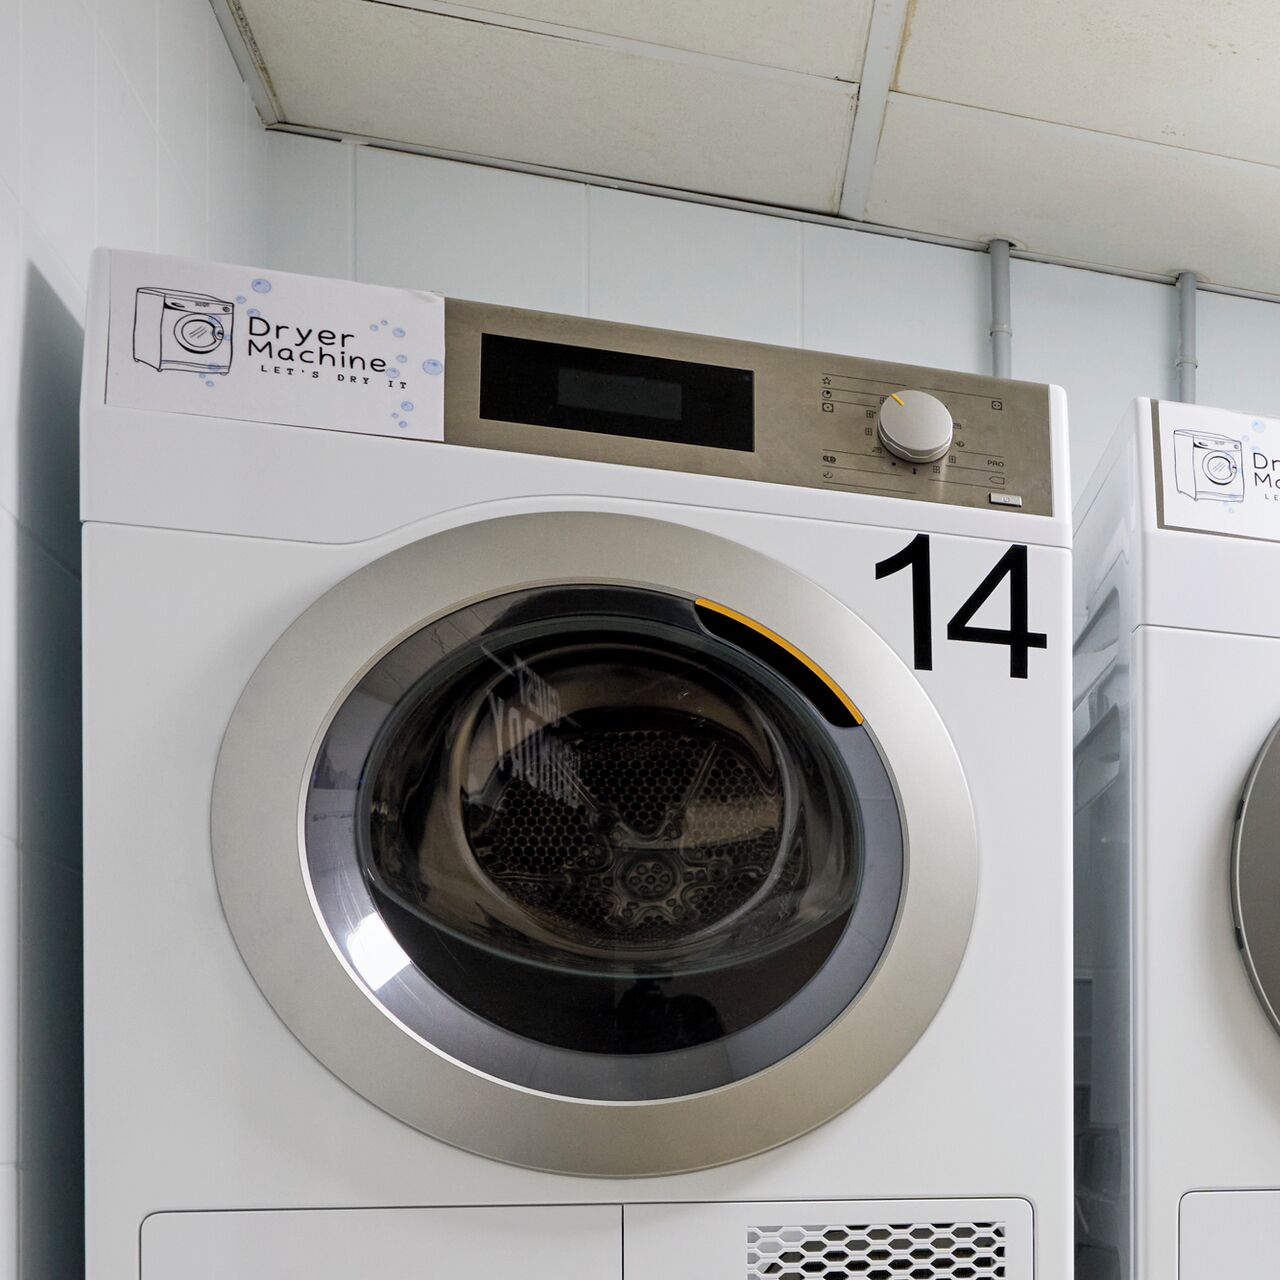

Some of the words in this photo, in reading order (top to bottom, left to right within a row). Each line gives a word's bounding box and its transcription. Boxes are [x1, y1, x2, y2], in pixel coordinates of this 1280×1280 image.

[248, 316, 355, 348] Dryer
[248, 339, 387, 373] Machine
[261, 365, 319, 380] LET'S
[337, 373, 370, 385] DRY
[388, 380, 407, 390] IT
[987, 459, 1004, 468] PRO
[875, 534, 1047, 679] 14
